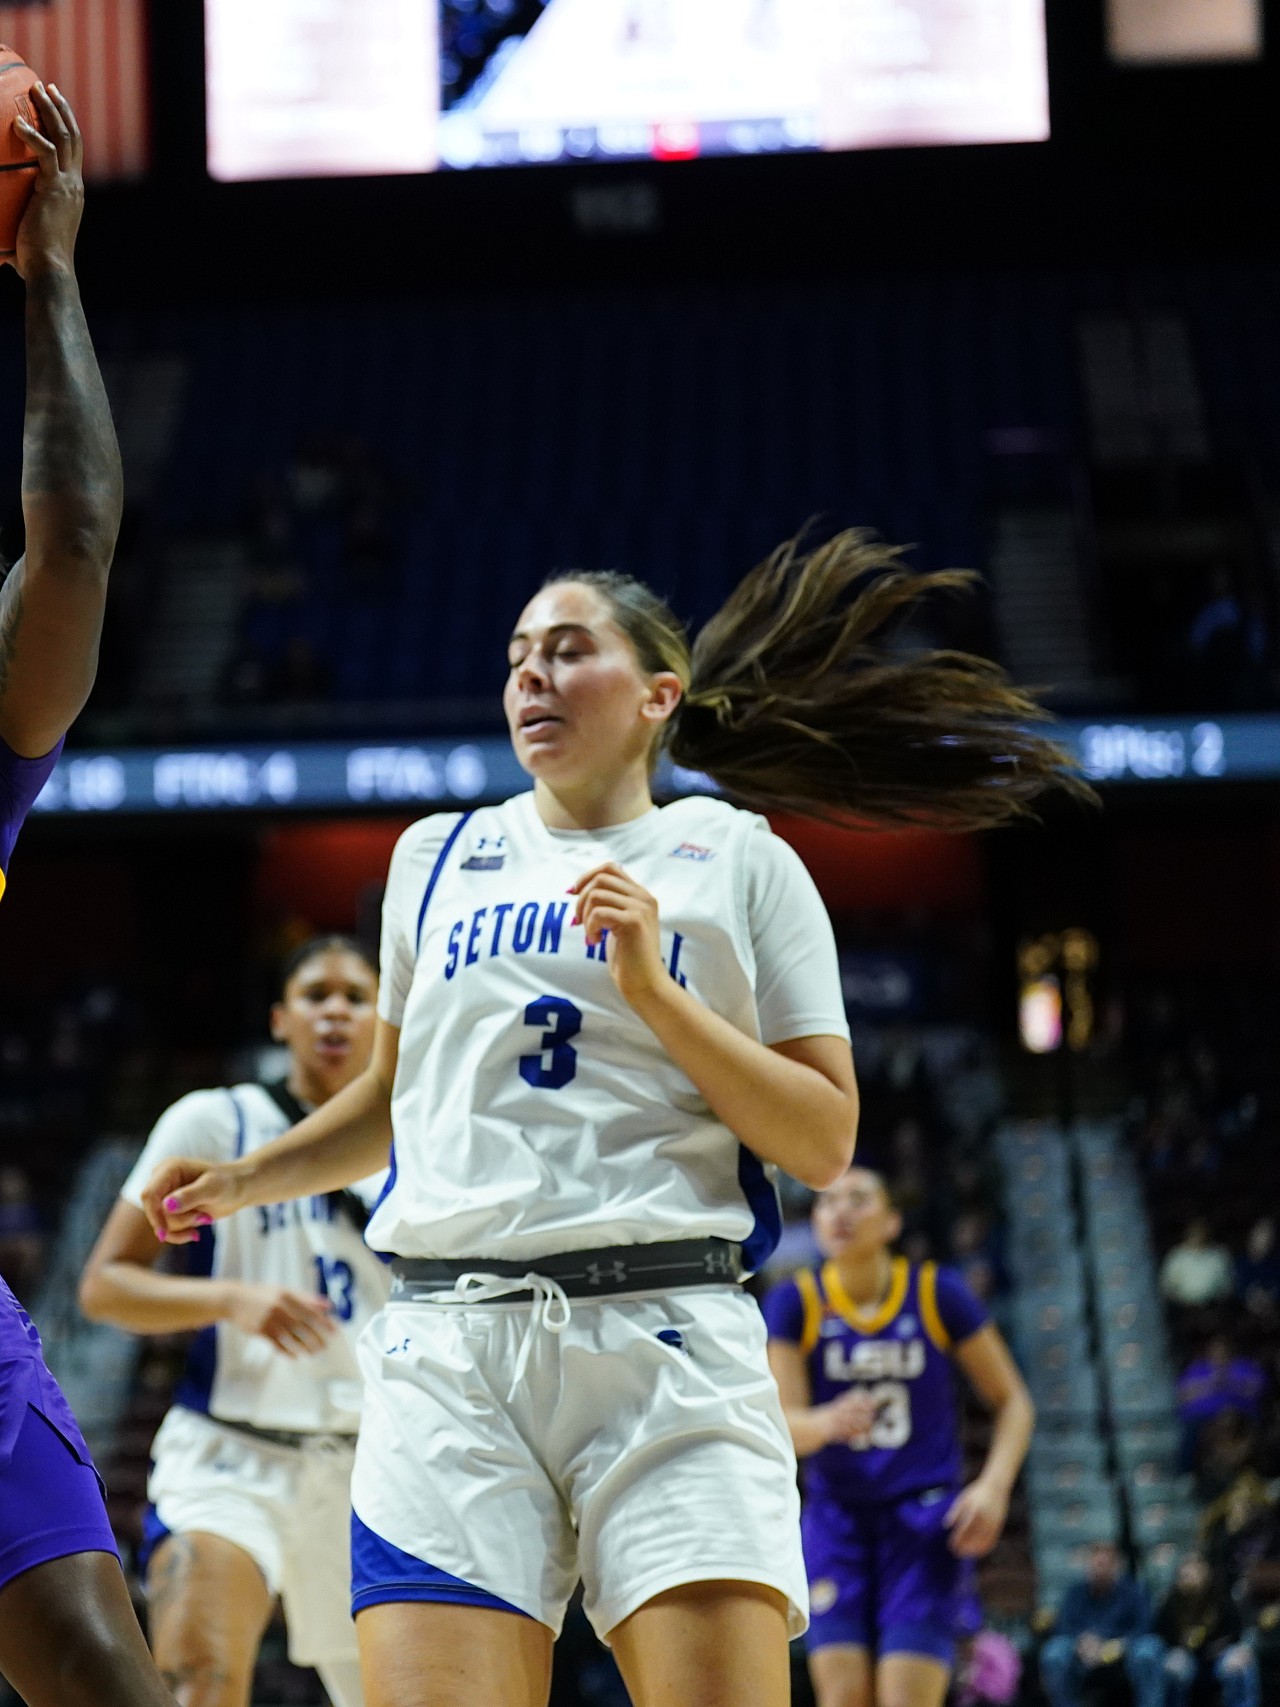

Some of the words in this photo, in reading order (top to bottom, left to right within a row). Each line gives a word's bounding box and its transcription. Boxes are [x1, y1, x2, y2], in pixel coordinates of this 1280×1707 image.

[444, 901, 568, 982] SETON
[519, 995, 582, 1090] 3
[315, 1254, 354, 1321] 13
[823, 1338, 927, 1382] LSU
[848, 1380, 911, 1451] 3
